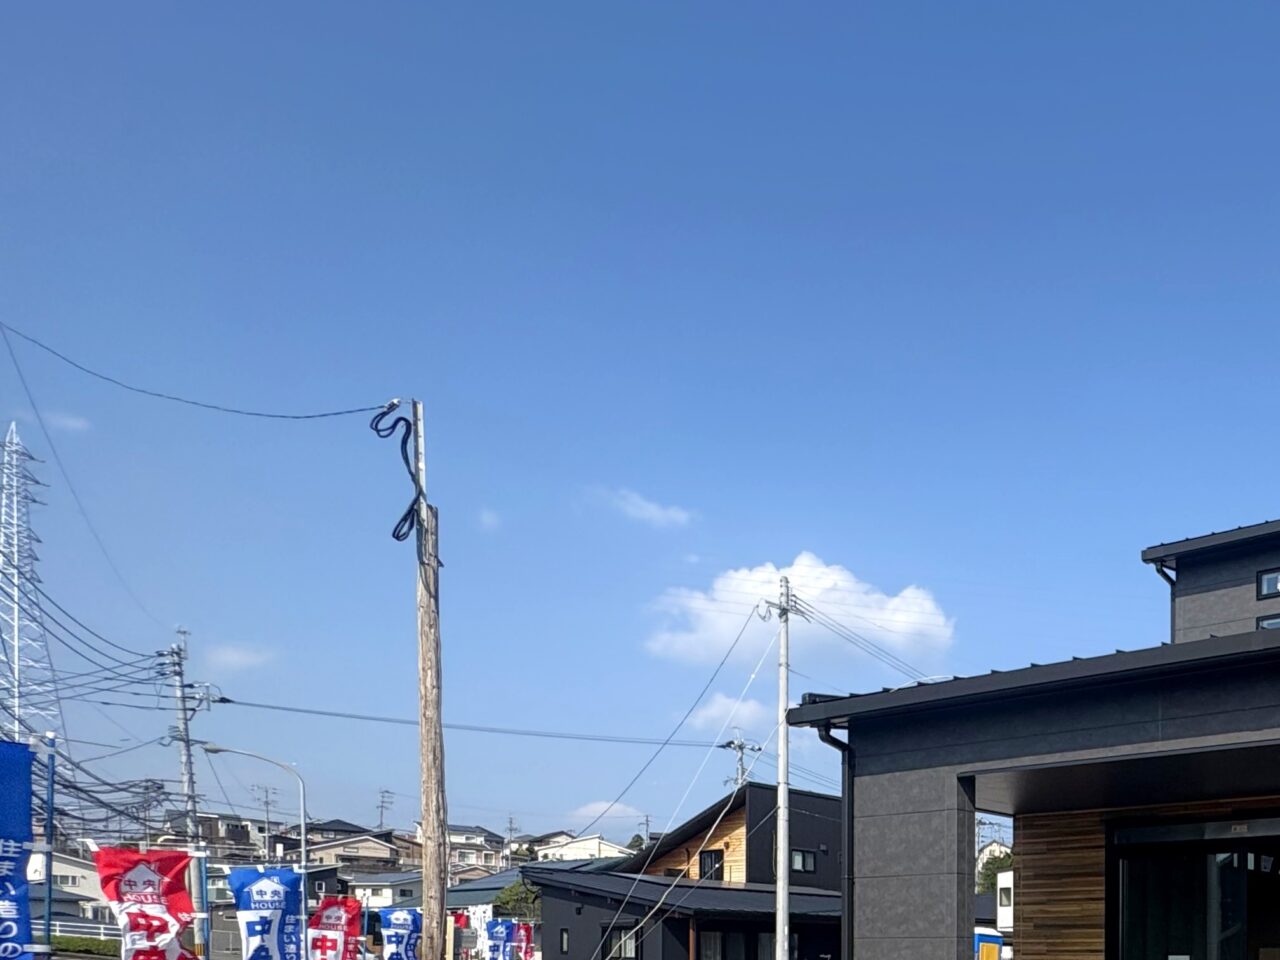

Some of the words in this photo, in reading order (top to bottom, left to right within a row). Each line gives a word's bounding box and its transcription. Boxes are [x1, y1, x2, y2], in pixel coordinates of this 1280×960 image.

[124, 879, 156, 890] 中央
[122, 893, 169, 904] HOUSE
[255, 889, 281, 898] 中央
